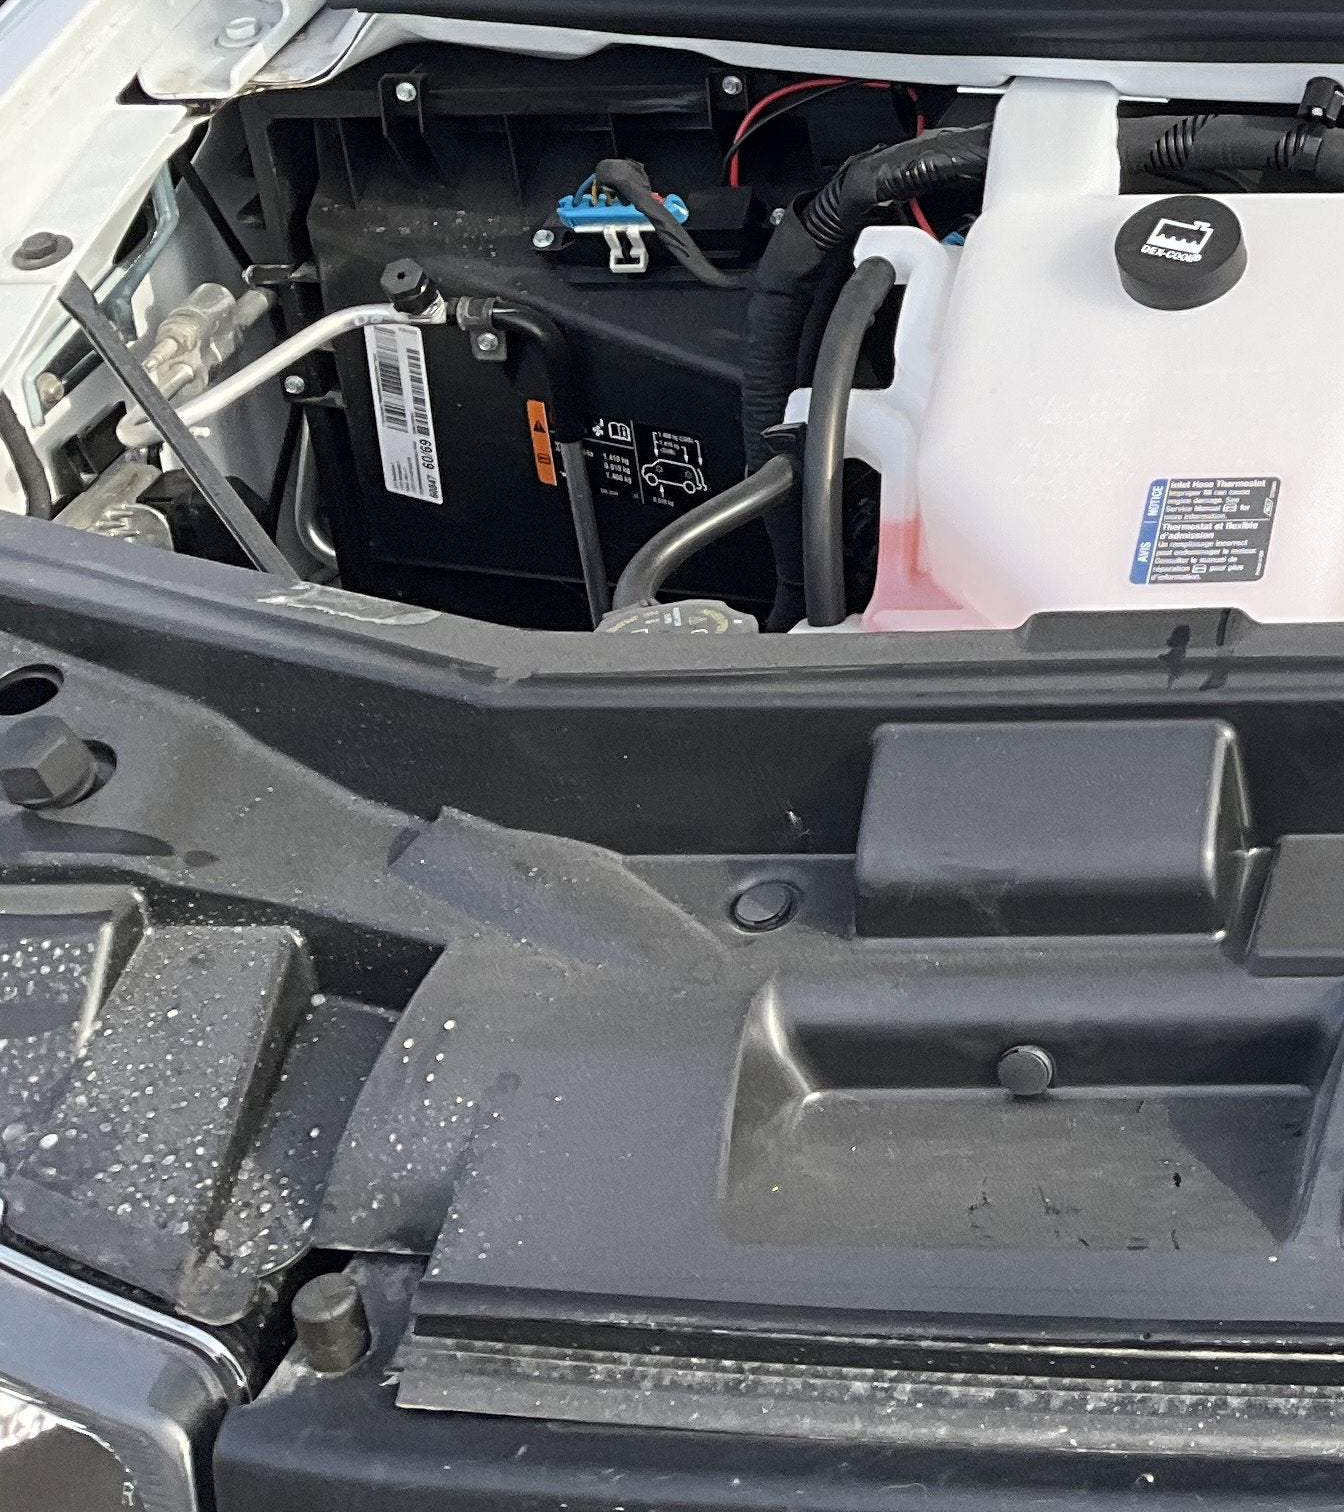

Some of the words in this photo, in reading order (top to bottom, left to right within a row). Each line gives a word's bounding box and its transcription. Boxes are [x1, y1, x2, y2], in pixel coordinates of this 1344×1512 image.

[419, 439, 435, 470] 60/69
[1216, 479, 1266, 487] Thermostat
[1148, 485, 1164, 517] NOTICE
[1162, 522, 1212, 531] Thermostat
[1137, 541, 1152, 563] AVIS
